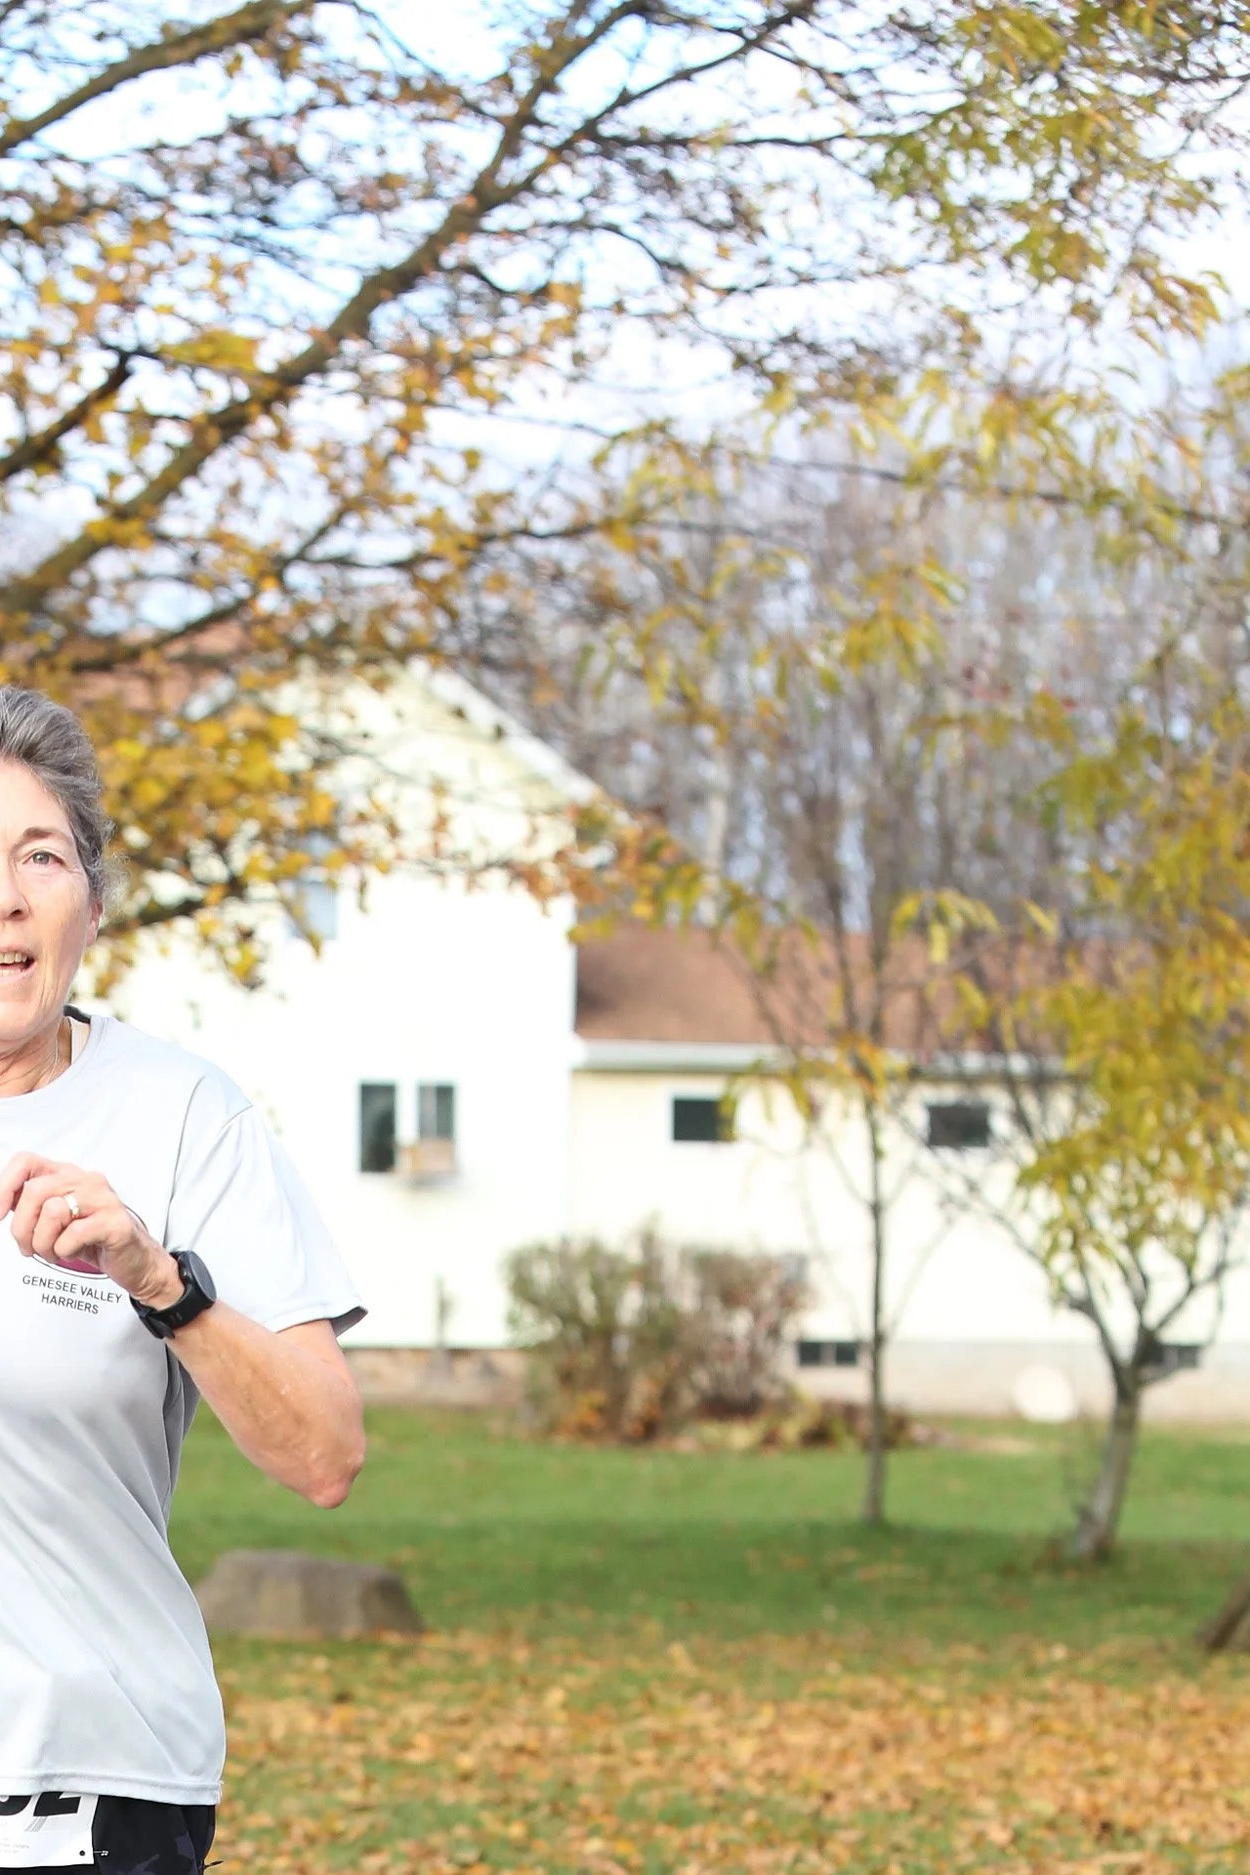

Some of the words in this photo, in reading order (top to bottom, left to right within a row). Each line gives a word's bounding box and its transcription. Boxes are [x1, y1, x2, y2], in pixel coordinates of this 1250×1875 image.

[22, 1274, 78, 1294] GENESEE
[80, 1285, 122, 1304] VALLEY
[41, 1294, 99, 1315] HARRIERS
